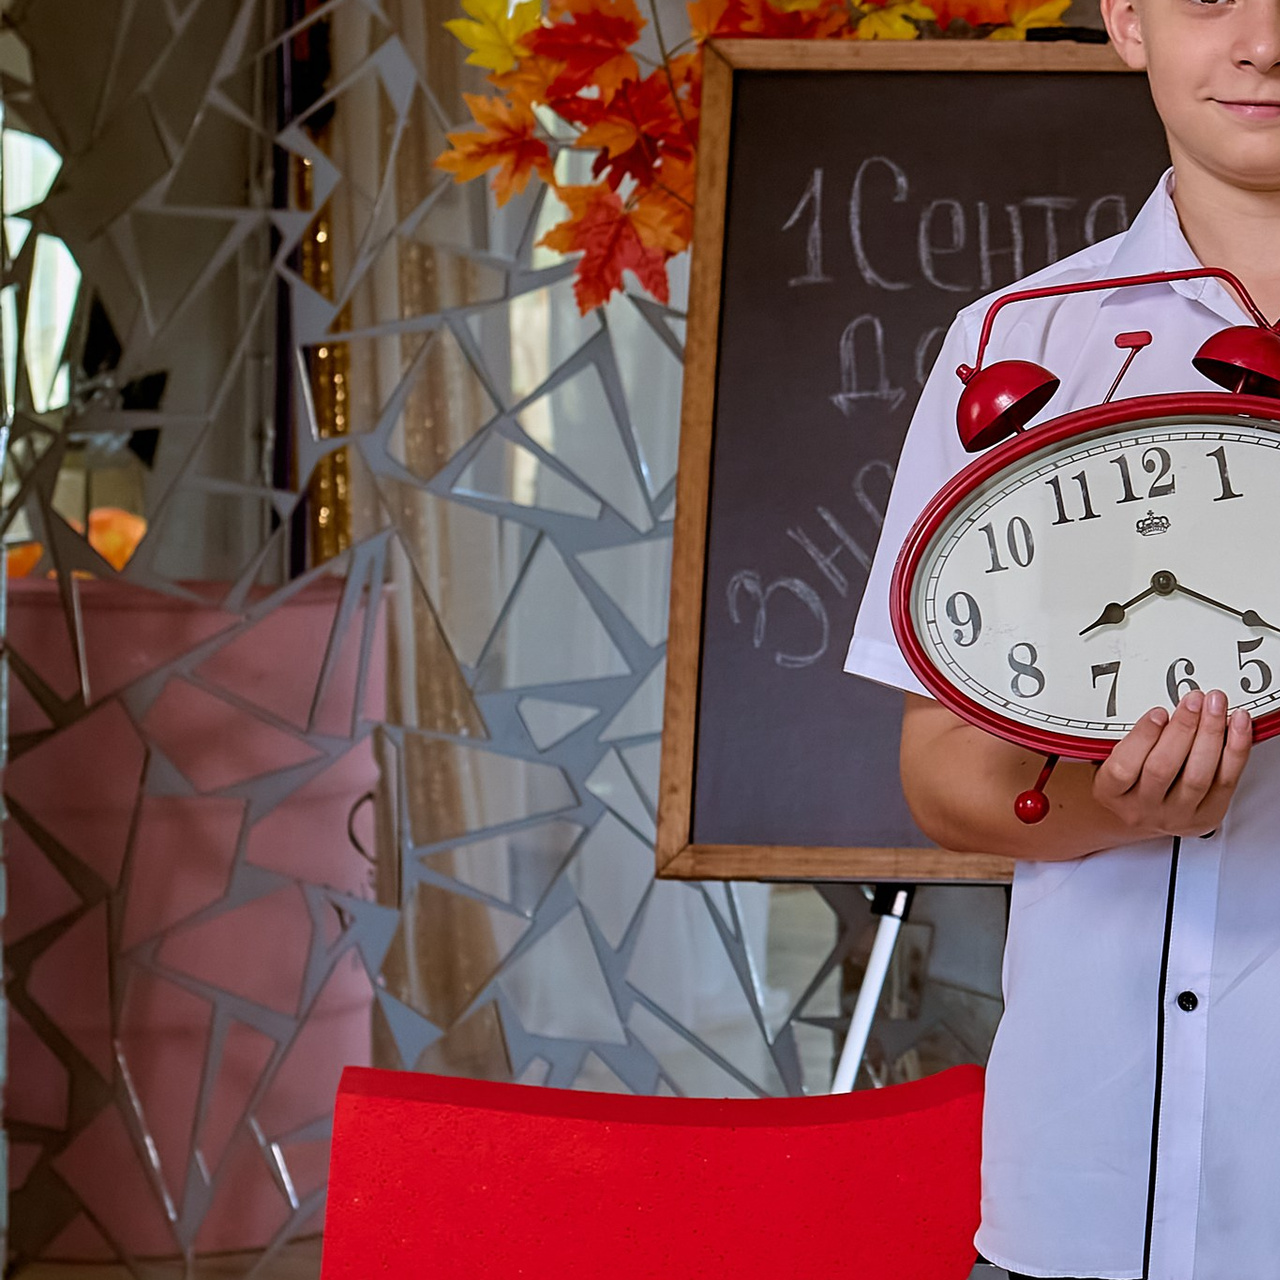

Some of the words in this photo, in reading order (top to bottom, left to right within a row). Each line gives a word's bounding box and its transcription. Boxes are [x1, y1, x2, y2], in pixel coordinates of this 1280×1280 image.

[1045, 469, 1101, 526] 11
[1110, 446, 1177, 504] 12
[1206, 445, 1244, 502] 1
[978, 516, 1035, 573] 10
[945, 590, 982, 648] 9
[1006, 641, 1047, 699] 8
[1090, 660, 1121, 717] 7
[1165, 657, 1202, 707] 6
[1236, 636, 1273, 695] 5
